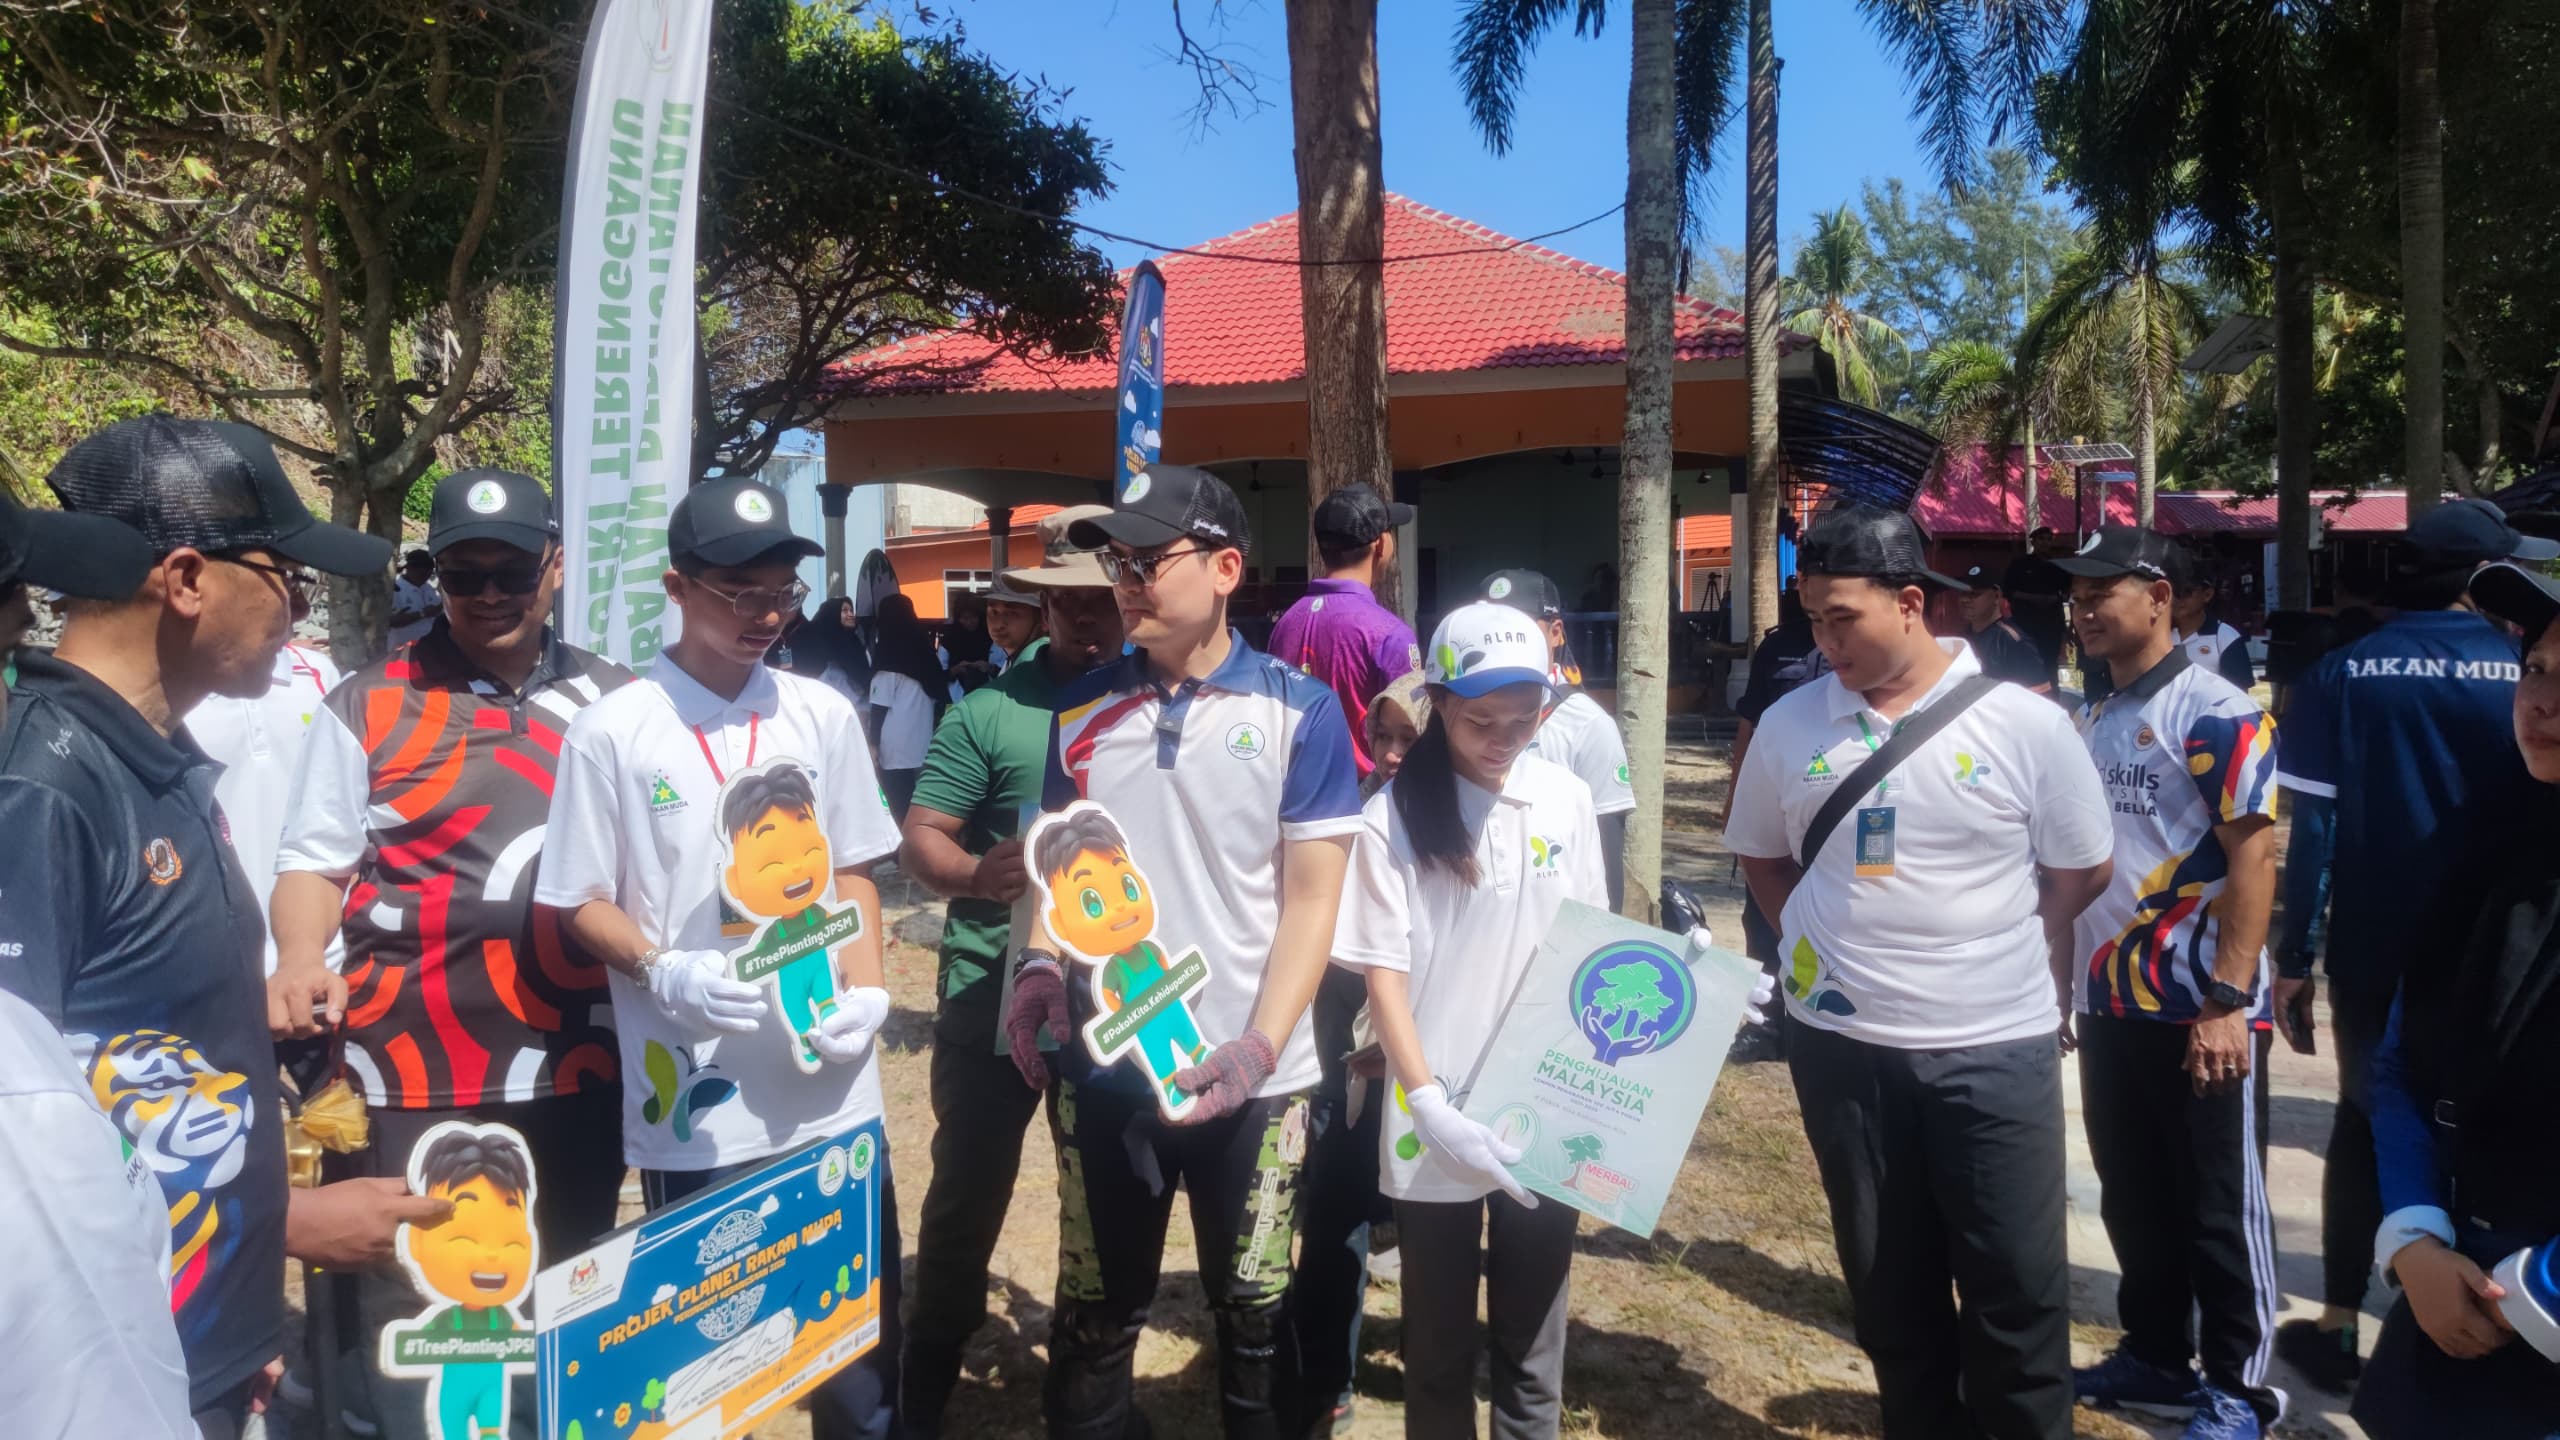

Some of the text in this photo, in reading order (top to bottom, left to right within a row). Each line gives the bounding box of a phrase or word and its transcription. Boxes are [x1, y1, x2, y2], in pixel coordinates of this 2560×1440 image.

[1483, 631, 1527, 646] ALAM
[2454, 660, 2522, 683] MUD
[2110, 786, 2158, 802] YSIA
[2114, 801, 2158, 817] BELIA
[744, 915, 853, 975] #TreePlantingJPSM
[1543, 1048, 1655, 1098] PENGHIJAUAN
[1536, 1060, 1646, 1116] MALAYSIA
[599, 1299, 674, 1353] PROJEK
[679, 1264, 742, 1310] PLANET
[746, 1233, 797, 1273] RAKAN
[801, 1209, 842, 1245] MUDA
[403, 1336, 535, 1360] #TreePlantingJPS
